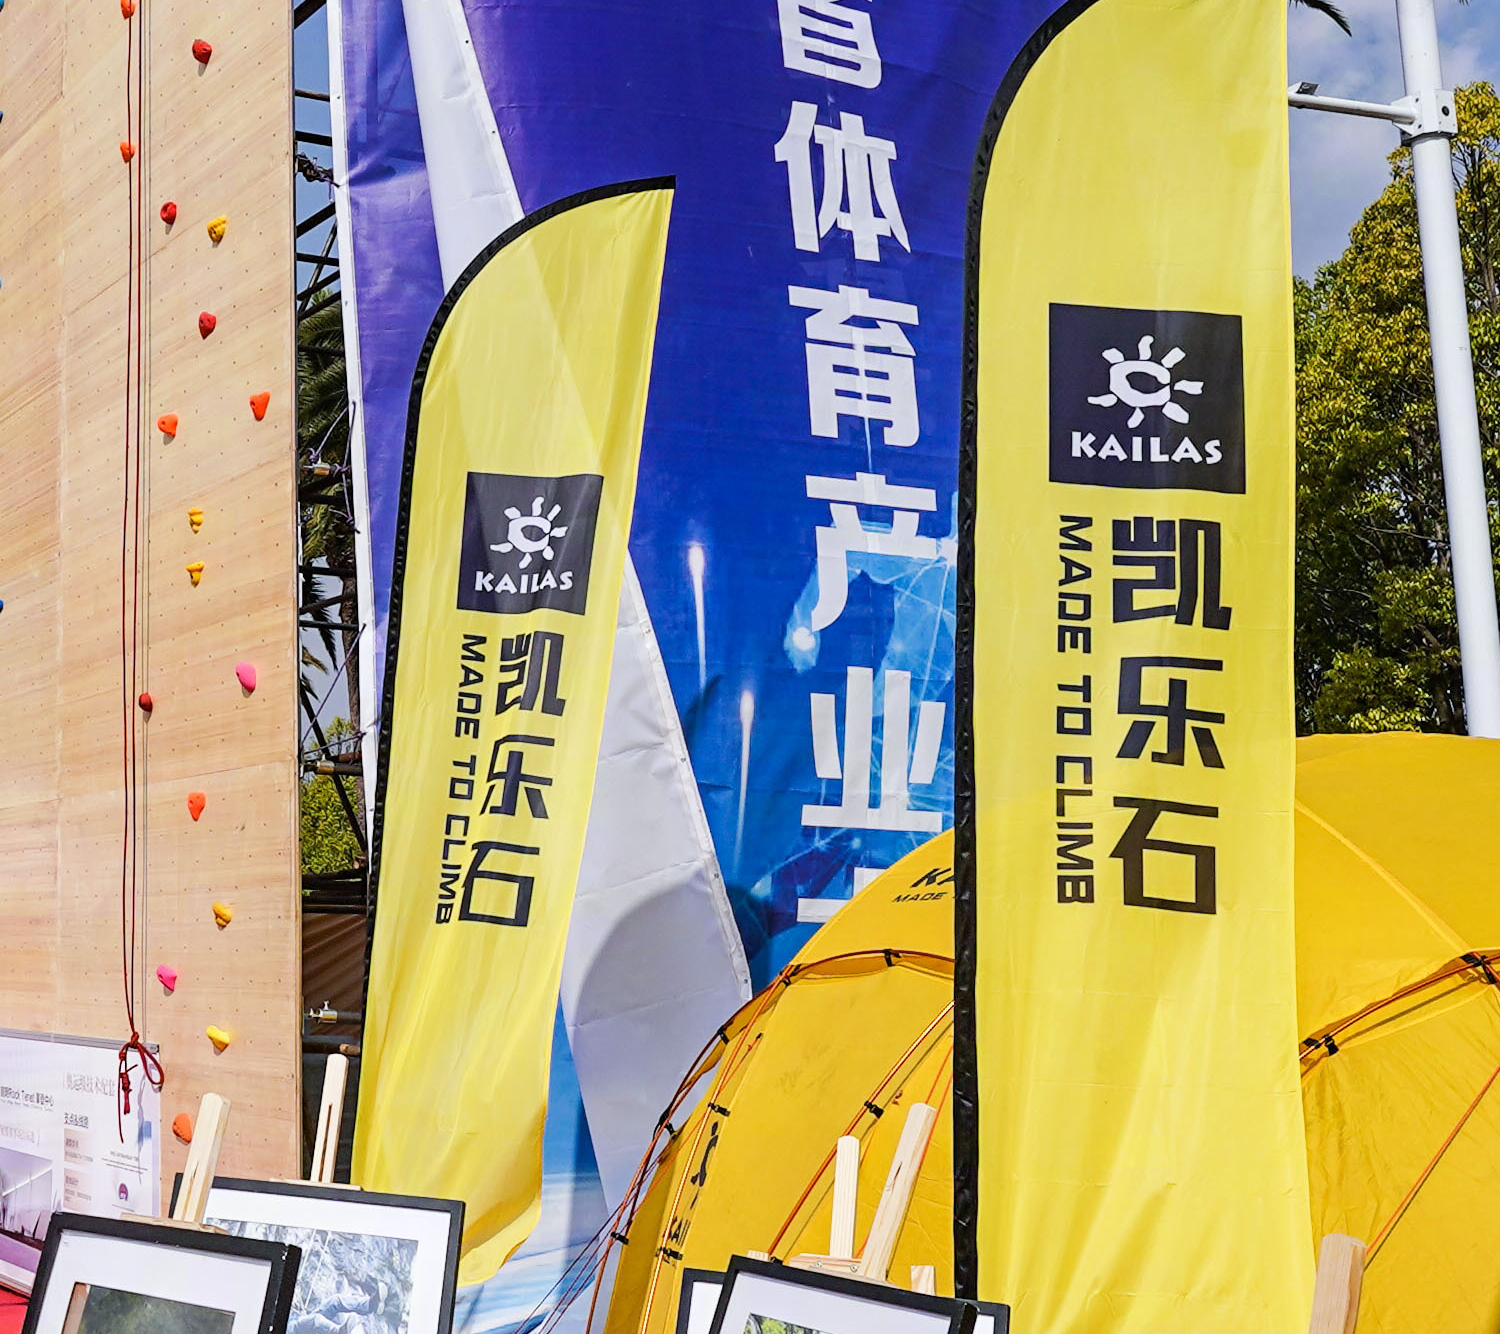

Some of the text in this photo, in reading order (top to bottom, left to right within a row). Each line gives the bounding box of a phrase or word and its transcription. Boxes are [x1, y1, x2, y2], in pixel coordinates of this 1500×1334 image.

[474, 570, 574, 594] KAILAS
[1070, 429, 1223, 467] KAILAS
[435, 634, 487, 924] MADE TO CLIMB
[458, 630, 567, 928] 凯乐石
[1055, 514, 1095, 905] MADE TO CLIMB
[1107, 514, 1232, 916] 凯乐石
[891, 892, 948, 903] MADE
